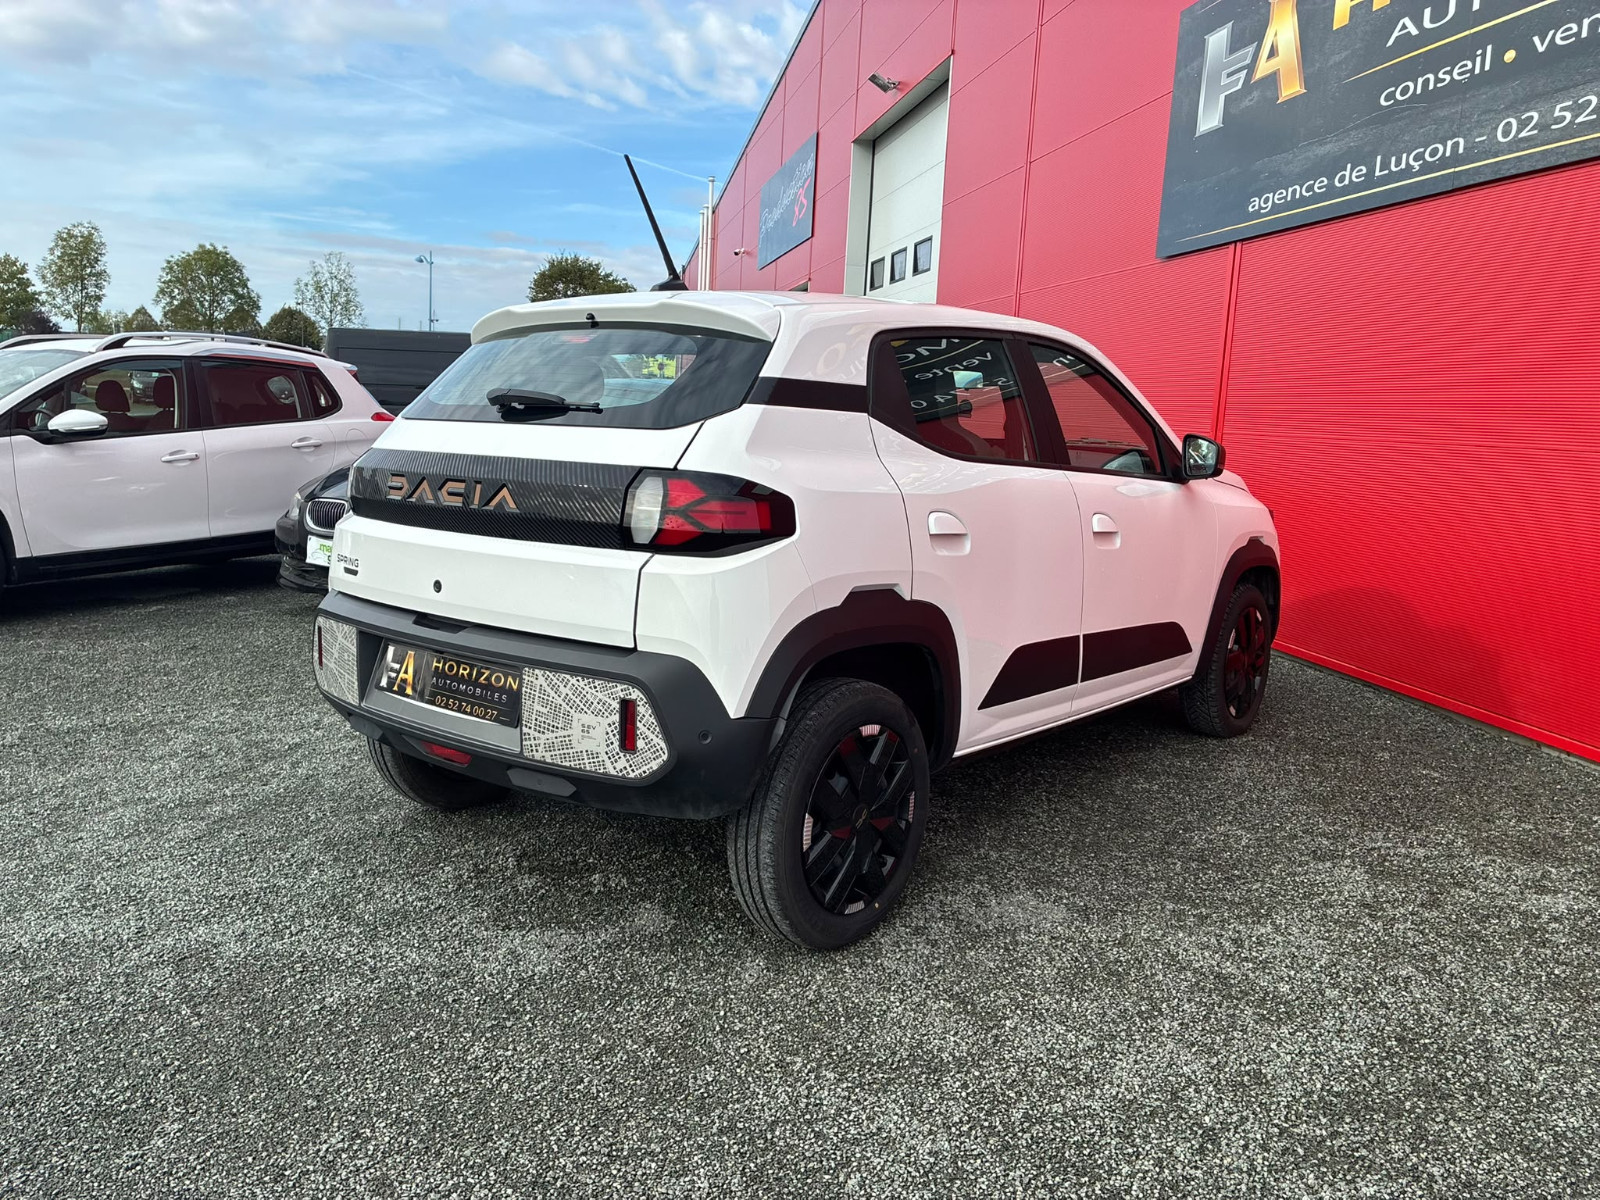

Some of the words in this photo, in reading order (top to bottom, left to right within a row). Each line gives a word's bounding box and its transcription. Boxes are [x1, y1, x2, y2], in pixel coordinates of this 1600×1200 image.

[1386, 0, 1480, 47] AU
[1380, 44, 1493, 107] conseil
[1248, 175, 1327, 213] agence
[1334, 163, 1367, 188] de
[1373, 136, 1465, 178] Luçon
[1496, 111, 1539, 143] 02
[1551, 95, 1597, 130] 52
[387, 473, 519, 512] DACIA
[337, 553, 360, 568] SPRING
[430, 676, 508, 704] AUTOMOBILES
[431, 657, 520, 692] HORIZON
[435, 695, 447, 707] 02
[447, 699, 460, 712] 52
[460, 702, 472, 714] 74
[472, 706, 486, 718] 00
[485, 709, 498, 721] 27
